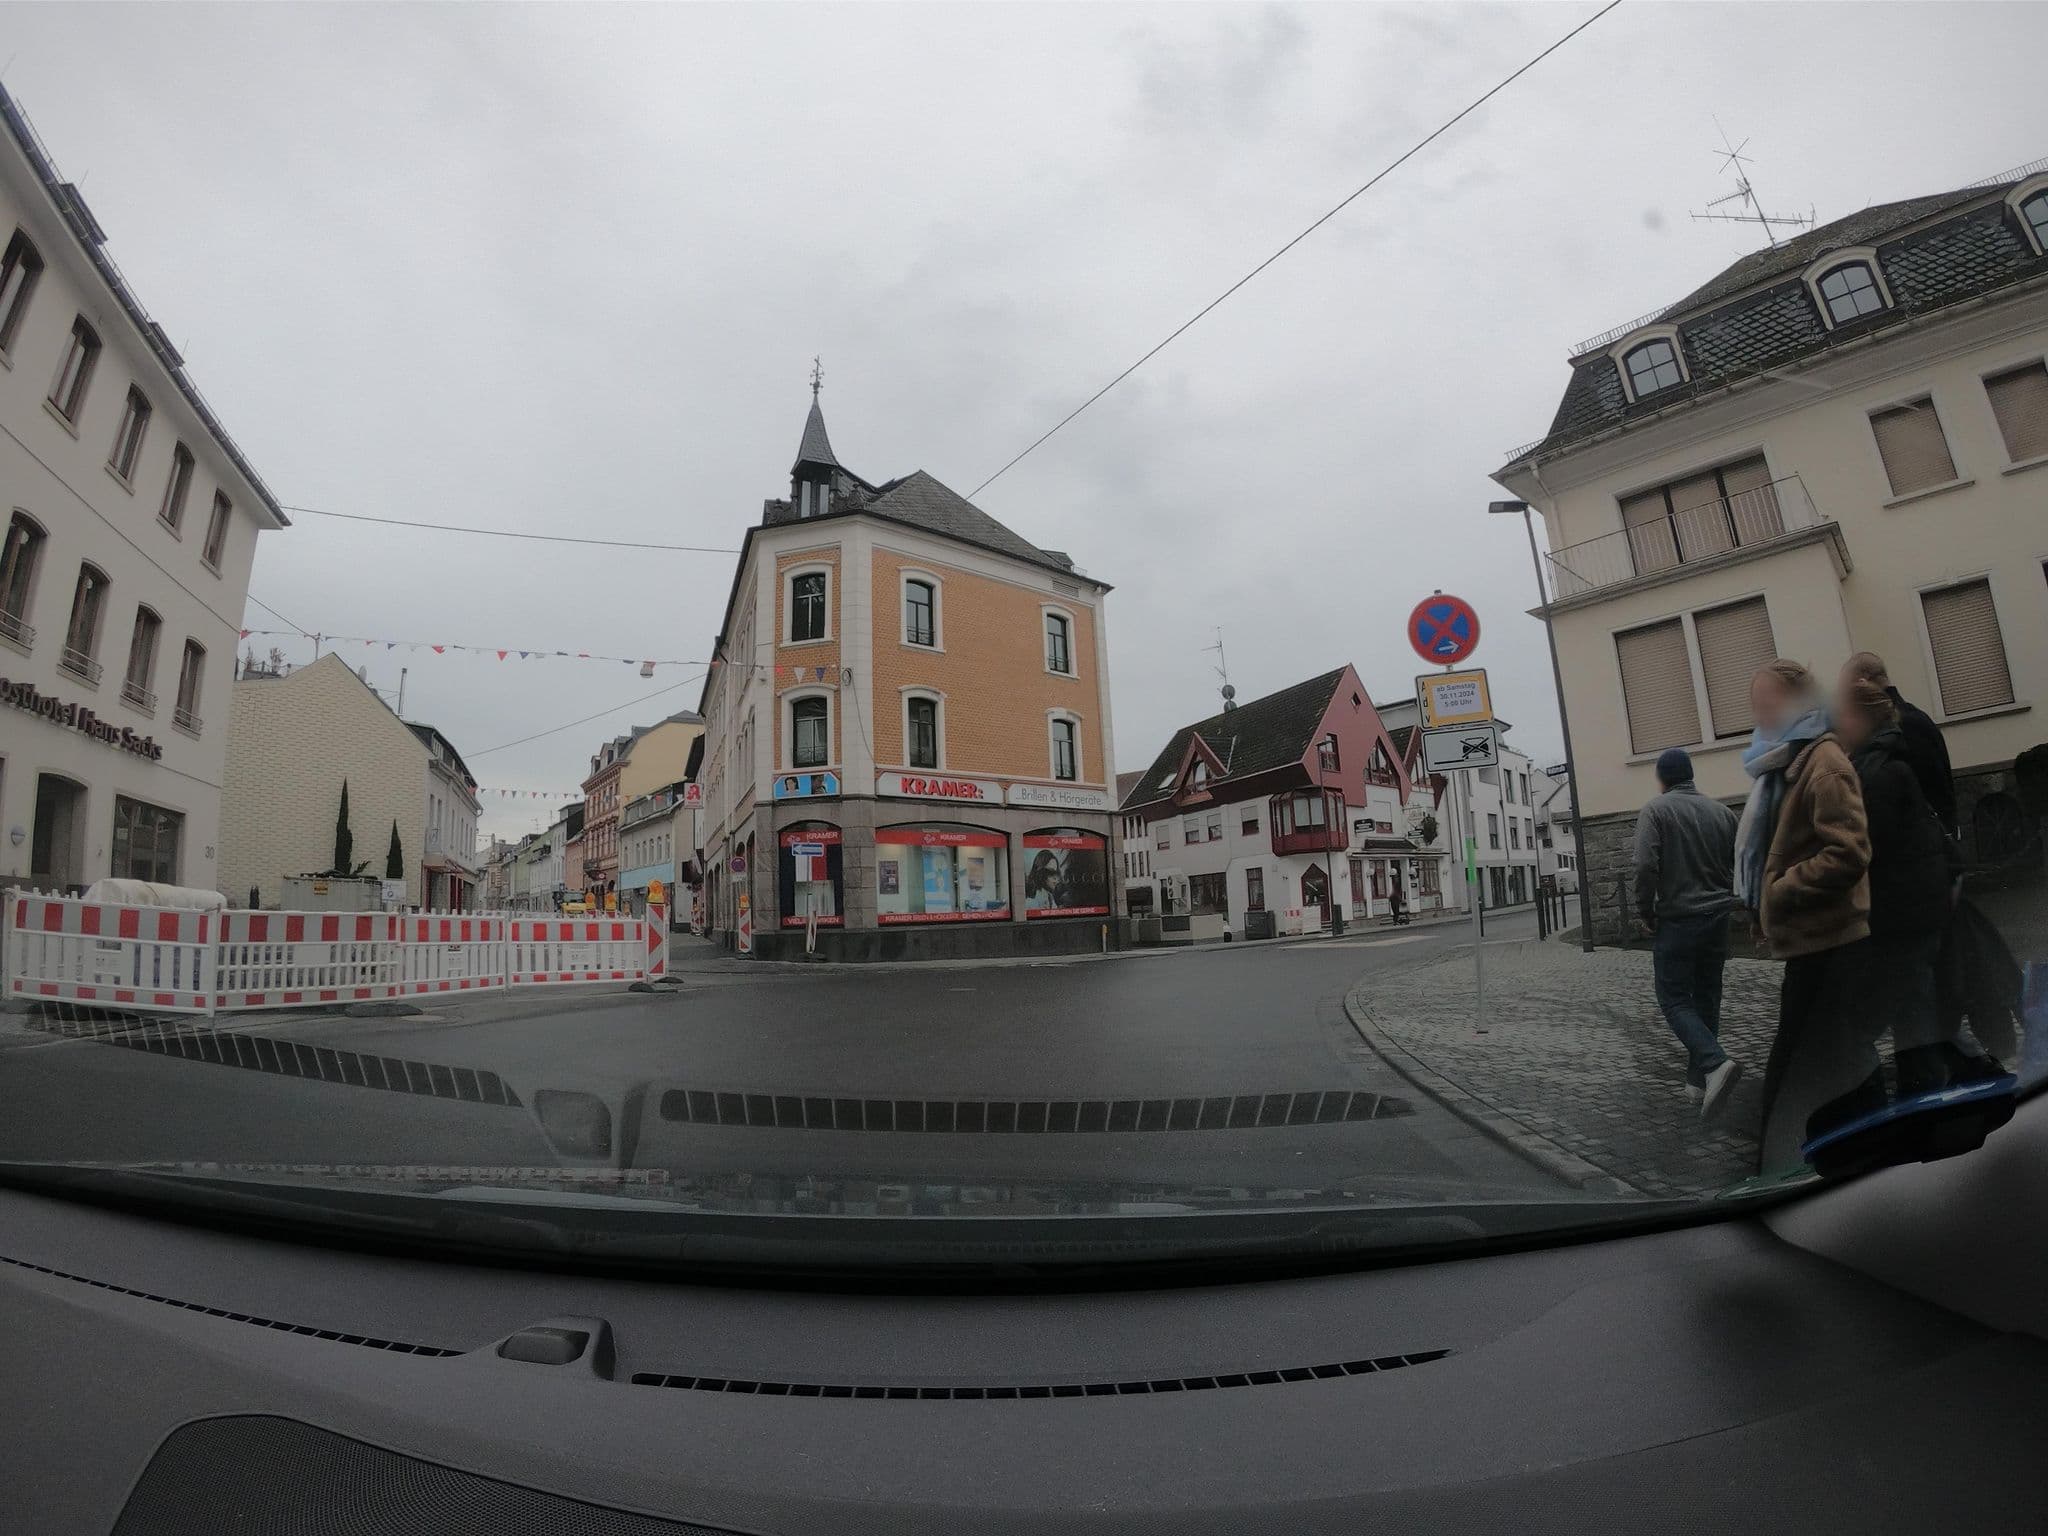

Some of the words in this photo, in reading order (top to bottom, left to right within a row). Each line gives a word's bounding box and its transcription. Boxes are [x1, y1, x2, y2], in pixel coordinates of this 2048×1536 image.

[1446, 683, 1476, 692] Samstag
[1439, 690, 1475, 700] 30.11.2024
[78, 707, 121, 744] Hans
[121, 727, 163, 761] Sachs
[1050, 790, 1057, 802] &
[940, 833, 967, 841] KRAMER
